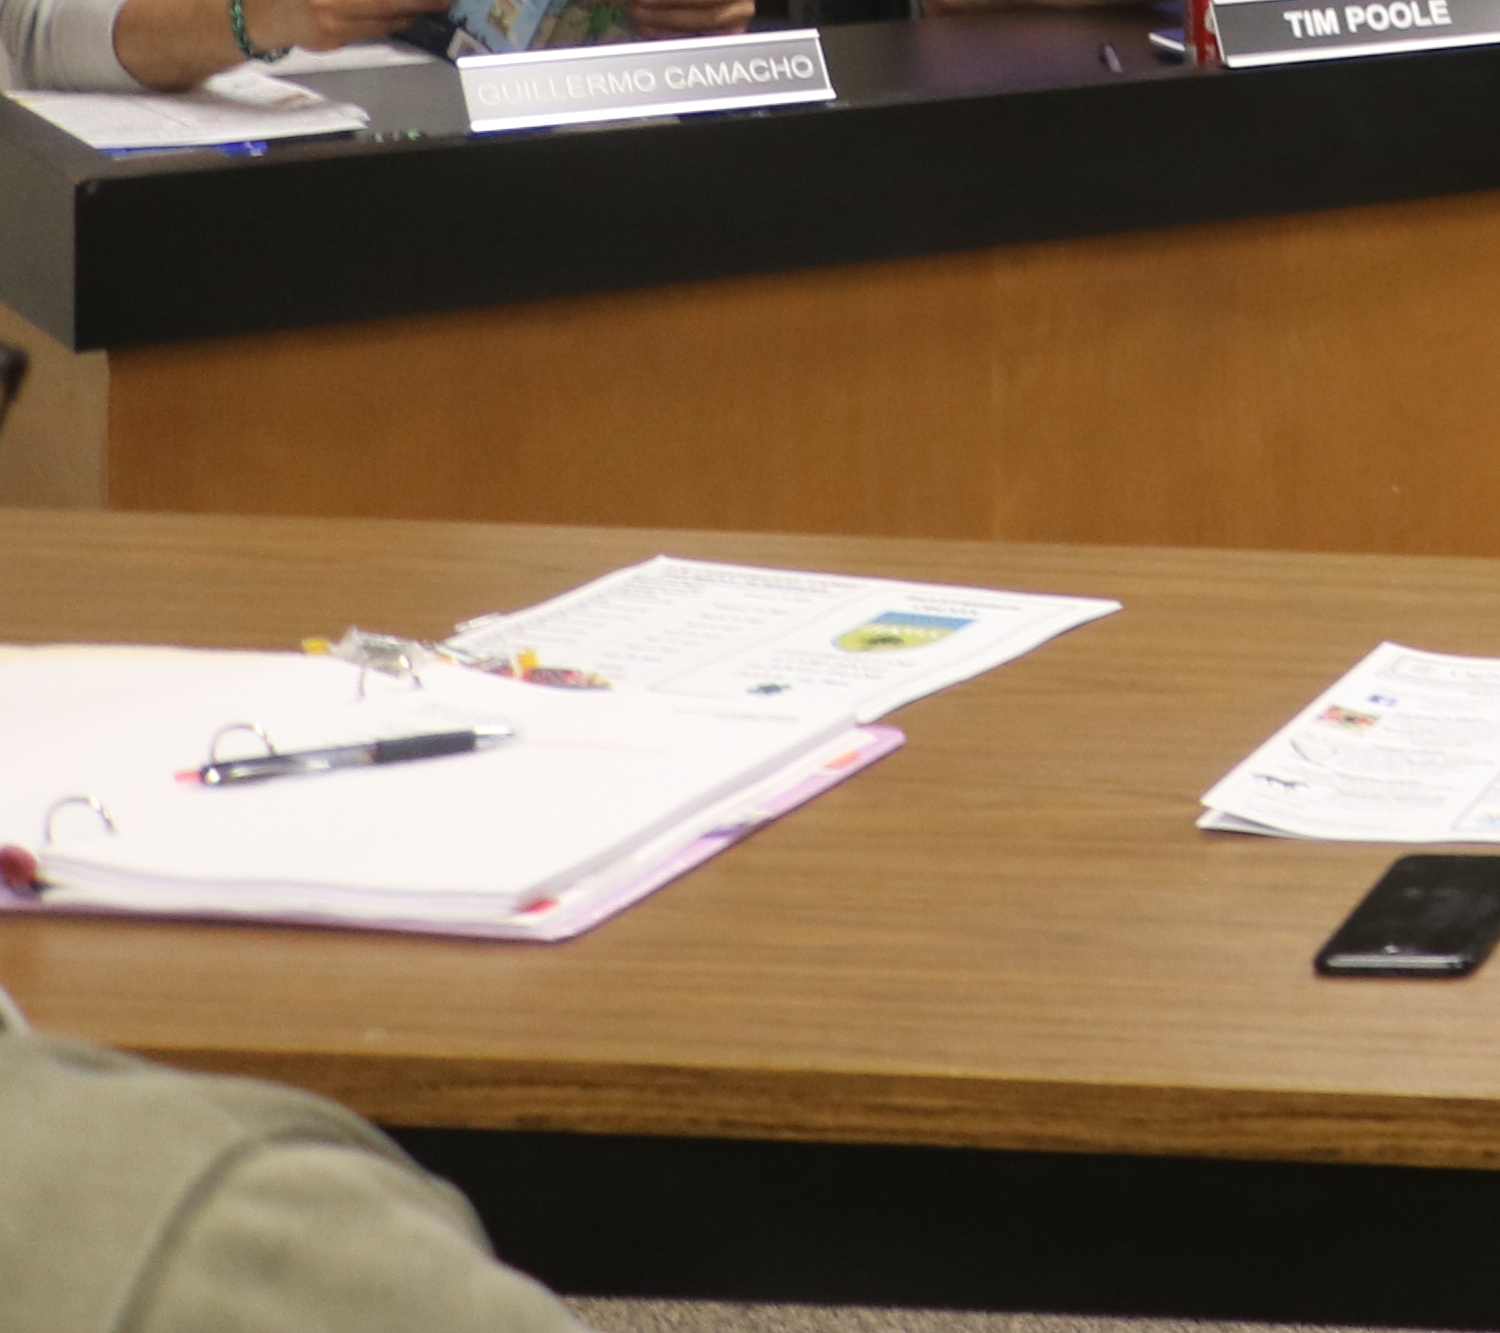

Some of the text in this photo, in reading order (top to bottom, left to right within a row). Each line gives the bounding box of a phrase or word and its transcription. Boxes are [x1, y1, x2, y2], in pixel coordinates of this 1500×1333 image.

[1283, 7, 1341, 39] TIM
[477, 54, 815, 108] GUILLERMO CAMACHO
